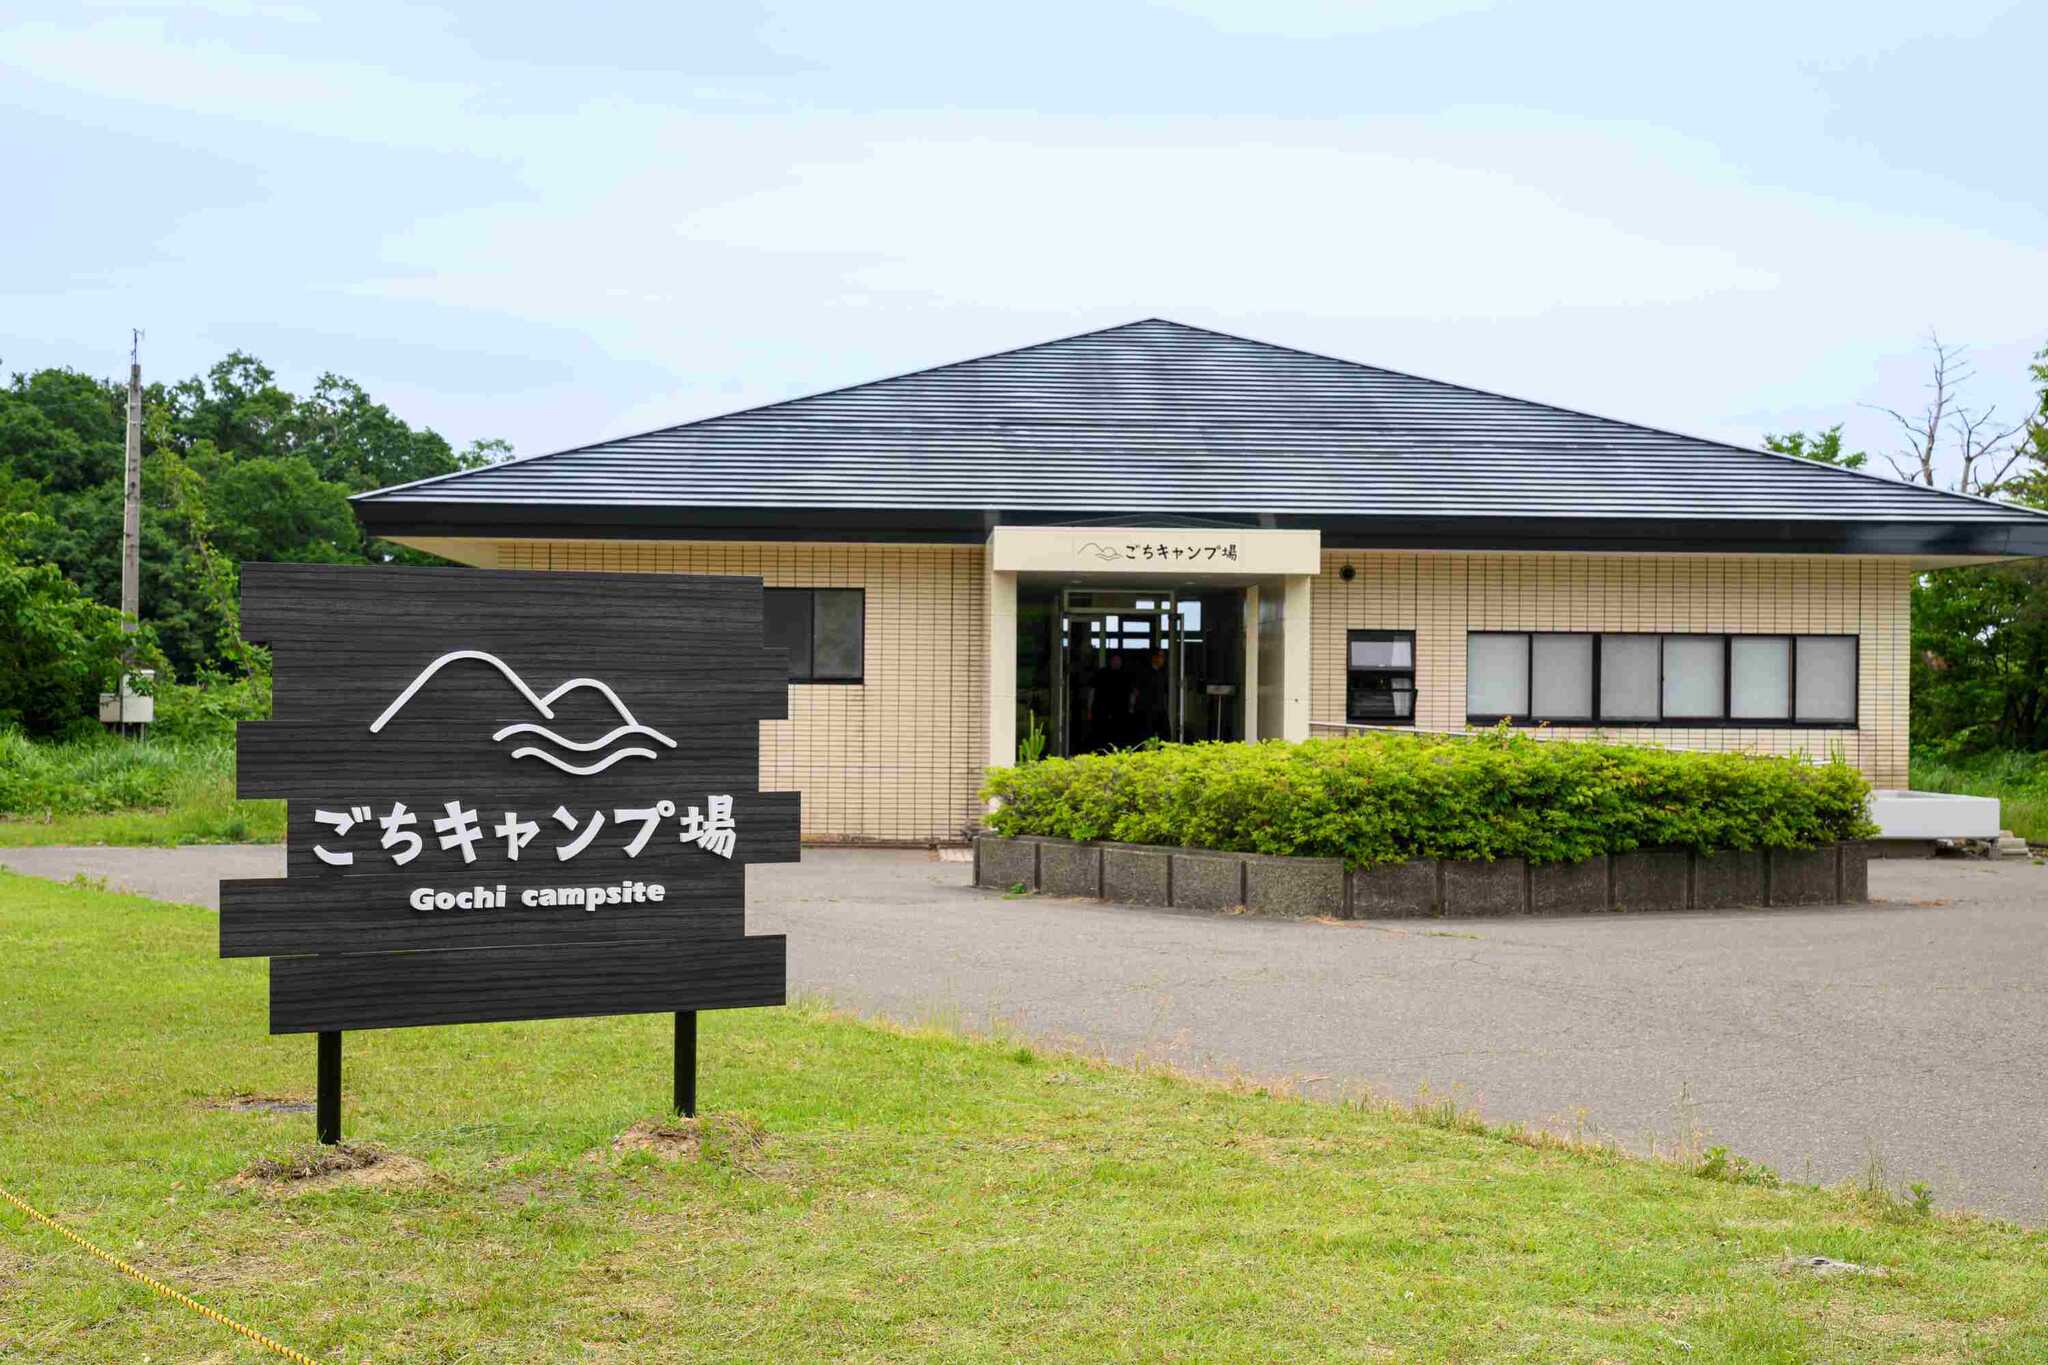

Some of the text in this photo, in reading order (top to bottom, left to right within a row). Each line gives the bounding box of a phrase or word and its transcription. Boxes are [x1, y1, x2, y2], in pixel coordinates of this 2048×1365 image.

[1125, 544, 1237, 561] ごちキャンプ場
[314, 795, 736, 865] ごちキャンプ場
[410, 881, 666, 912] Gochi campsite
